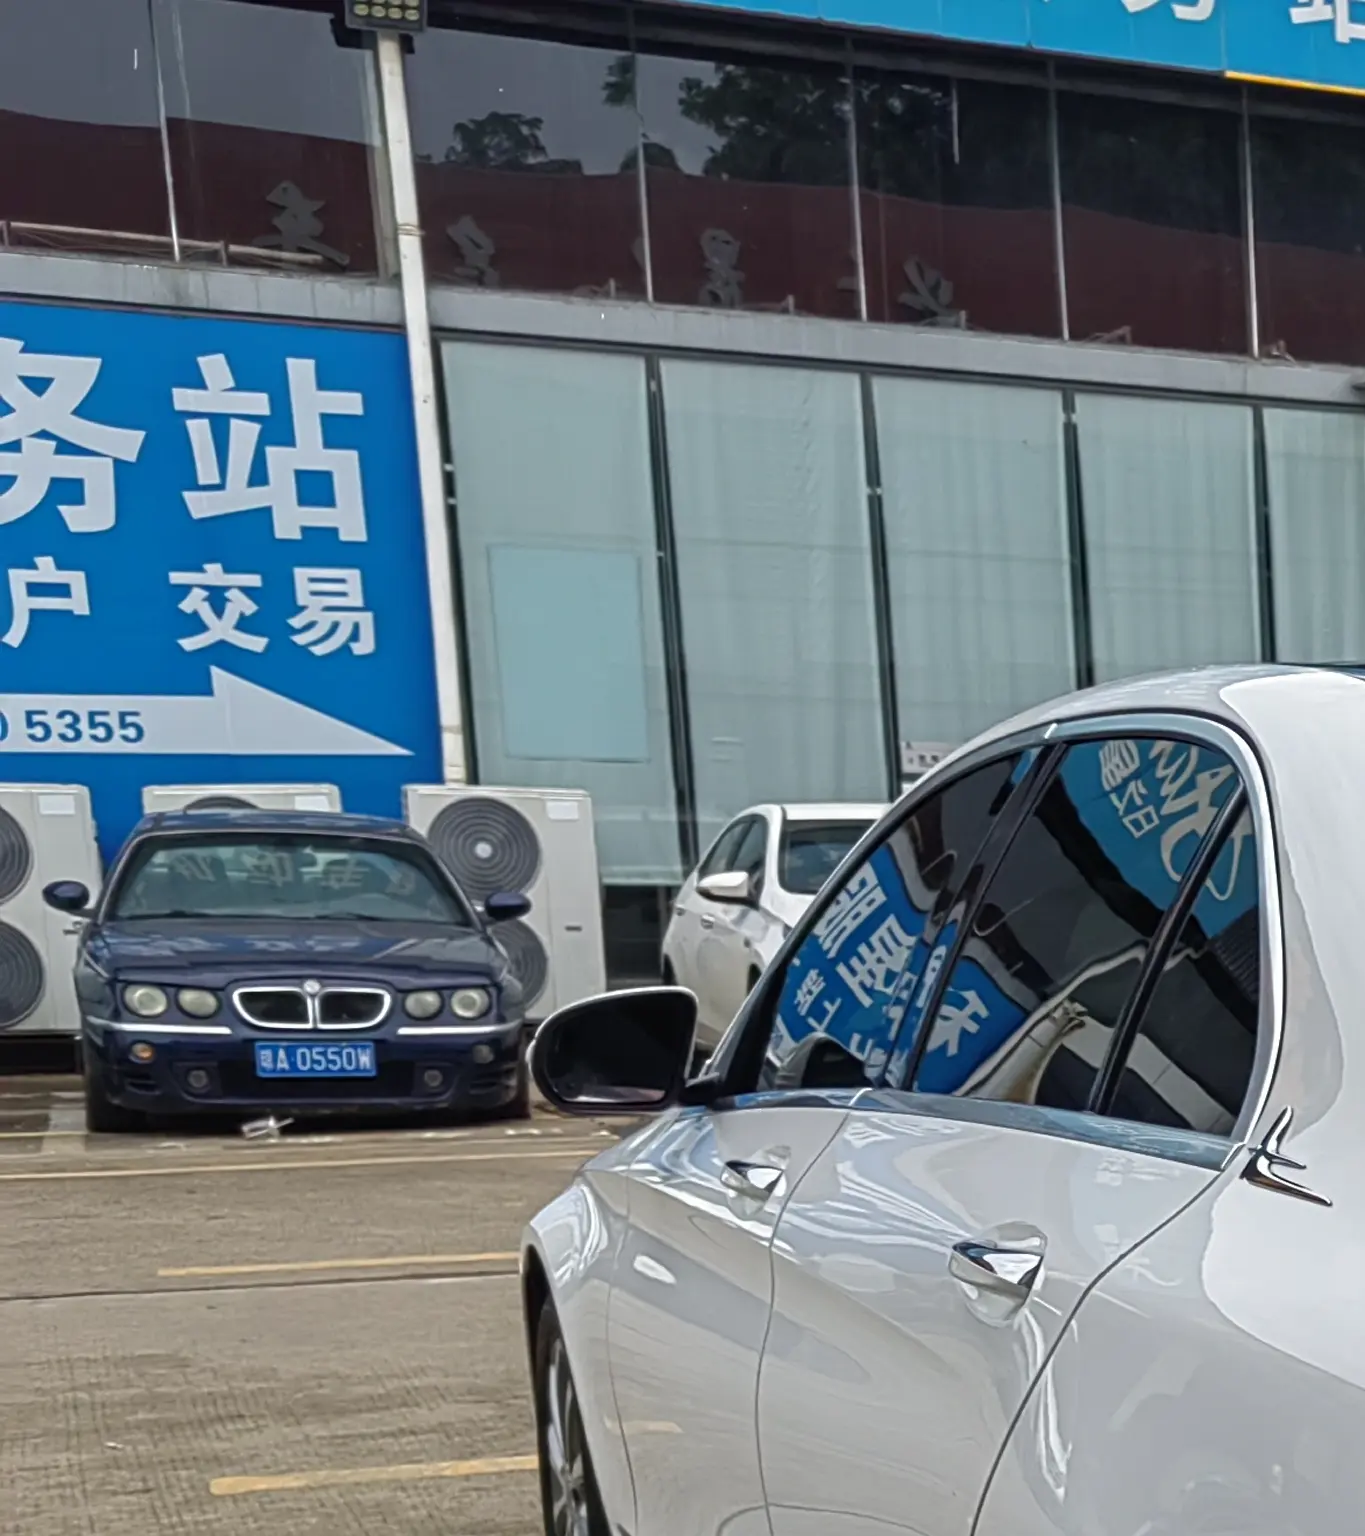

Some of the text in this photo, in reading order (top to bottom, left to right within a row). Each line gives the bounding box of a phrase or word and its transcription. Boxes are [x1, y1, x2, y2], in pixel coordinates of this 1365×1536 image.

[0, 337, 368, 542] 务站
[169, 563, 376, 656] 交易
[25, 709, 145, 744] 5355
